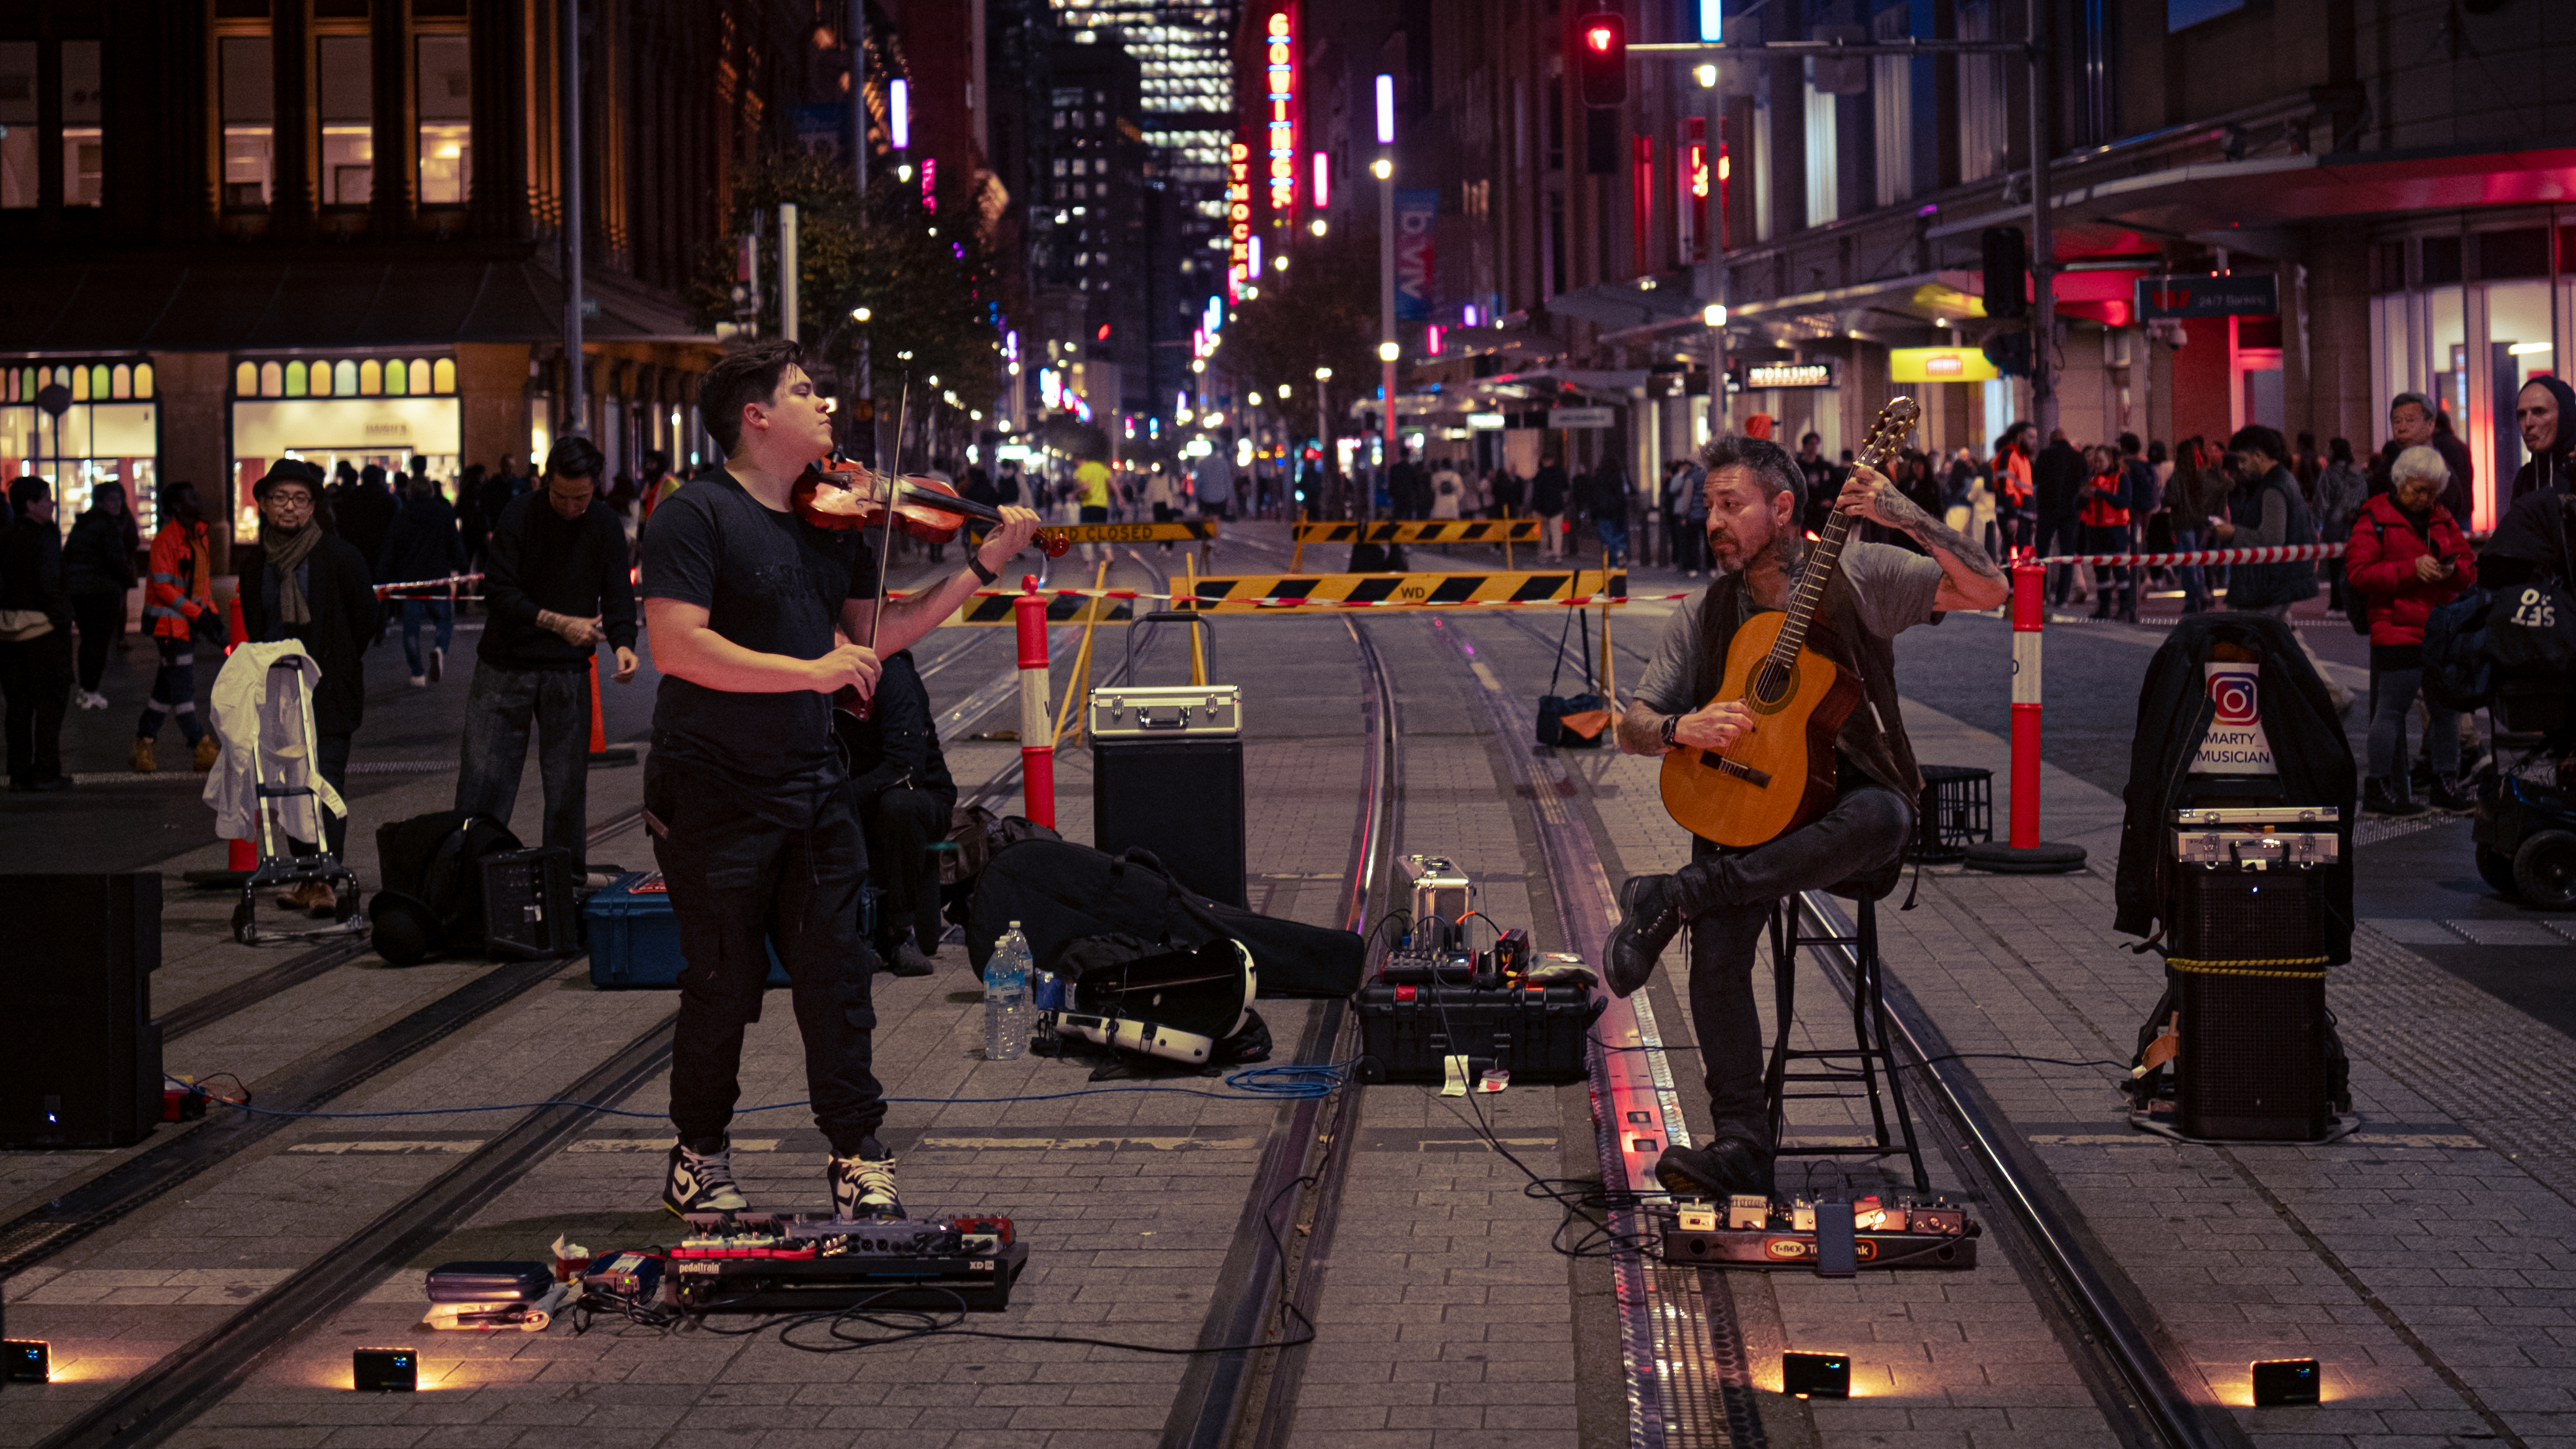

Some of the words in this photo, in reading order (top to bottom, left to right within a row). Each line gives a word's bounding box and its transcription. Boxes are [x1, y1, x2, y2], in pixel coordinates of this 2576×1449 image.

[1269, 13, 1291, 209] GOWINGS
[1750, 365, 1827, 380] WORKSHOP
[1086, 526, 1152, 541] CLOSED
[1401, 587, 1425, 599] WD
[2198, 750, 2269, 763] MUSICIAN
[679, 1263, 720, 1274] pedaltrain
[970, 1261, 984, 1269] XD
